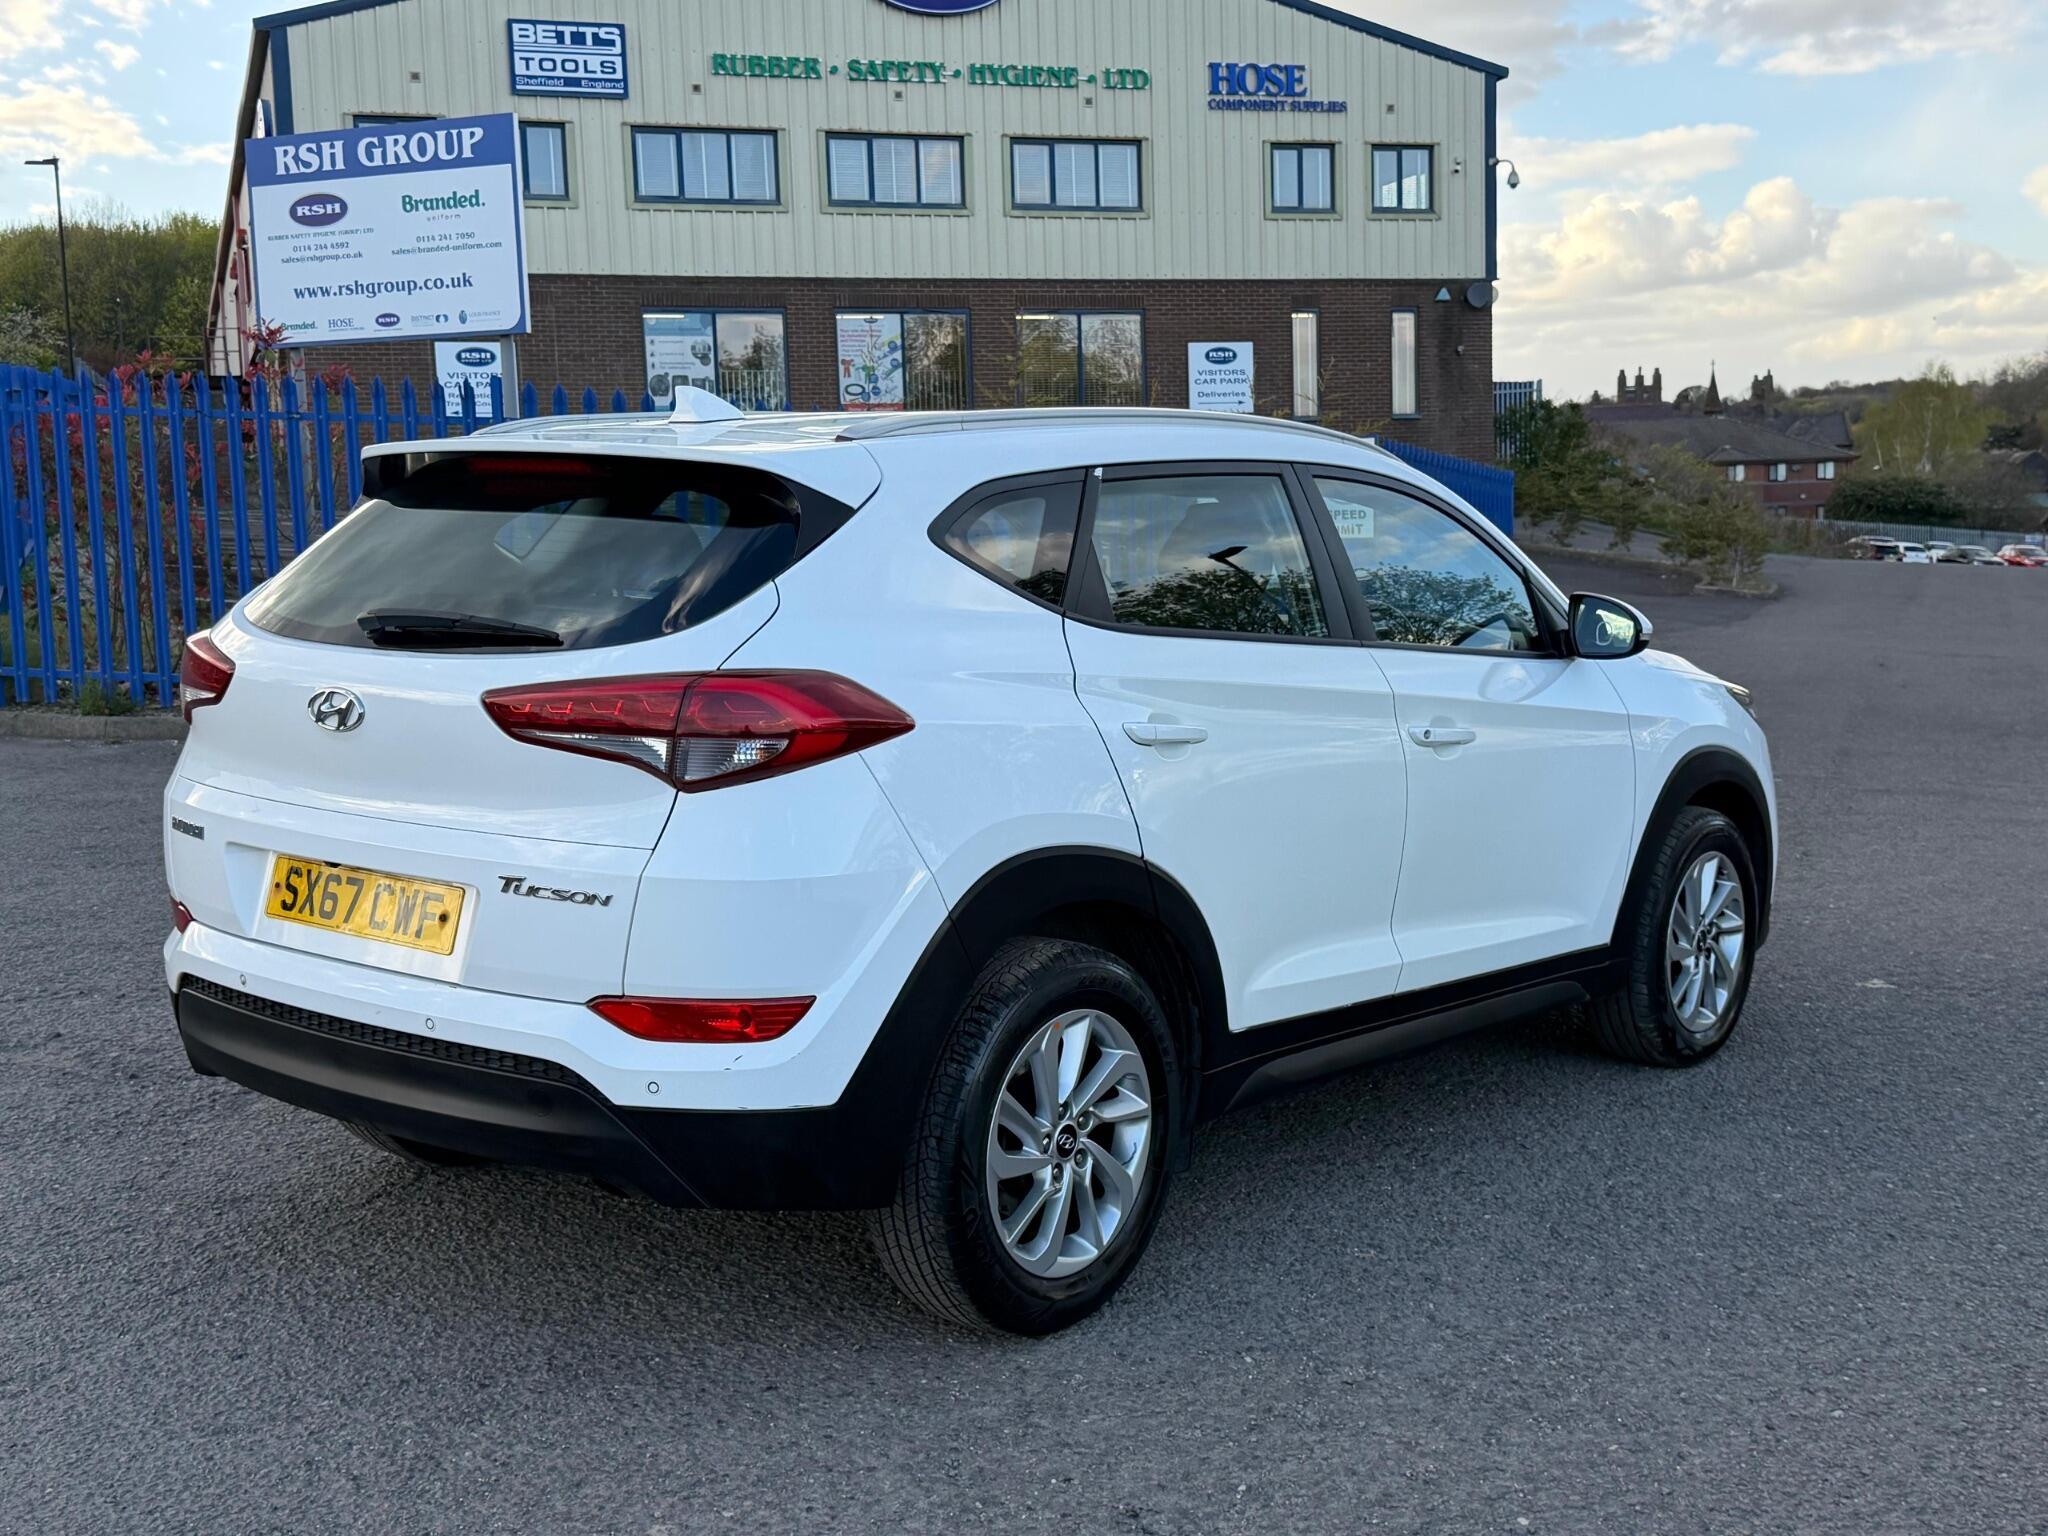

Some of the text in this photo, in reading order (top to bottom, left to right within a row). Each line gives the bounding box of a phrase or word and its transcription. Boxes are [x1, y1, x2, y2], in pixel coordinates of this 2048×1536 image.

[512, 23, 621, 55] BETTS
[519, 56, 617, 75] TOOLS
[712, 53, 1151, 90] RUBBER SAFETY HYGIENE LTD
[516, 76, 624, 90] Sheffield England
[1207, 62, 1307, 97] HOSE
[1208, 98, 1348, 113] COMPONENT SUPPLIES
[274, 127, 484, 176] RSH GROUP
[401, 189, 486, 213] Branded.
[296, 203, 341, 217] RSH
[427, 213, 461, 222] uniform
[416, 232, 475, 243] 0114 241 7050
[293, 241, 349, 253] 0114 244 4592
[294, 272, 473, 299] www.rshgroup.co.uk
[328, 318, 355, 328] HOSE
[1197, 369, 1246, 377] VISITORS
[1194, 377, 1248, 386] CAR PARK
[1197, 390, 1246, 398] Deliveries
[1330, 508, 1367, 521] PEED
[280, 866, 445, 939] SX67 CWF
